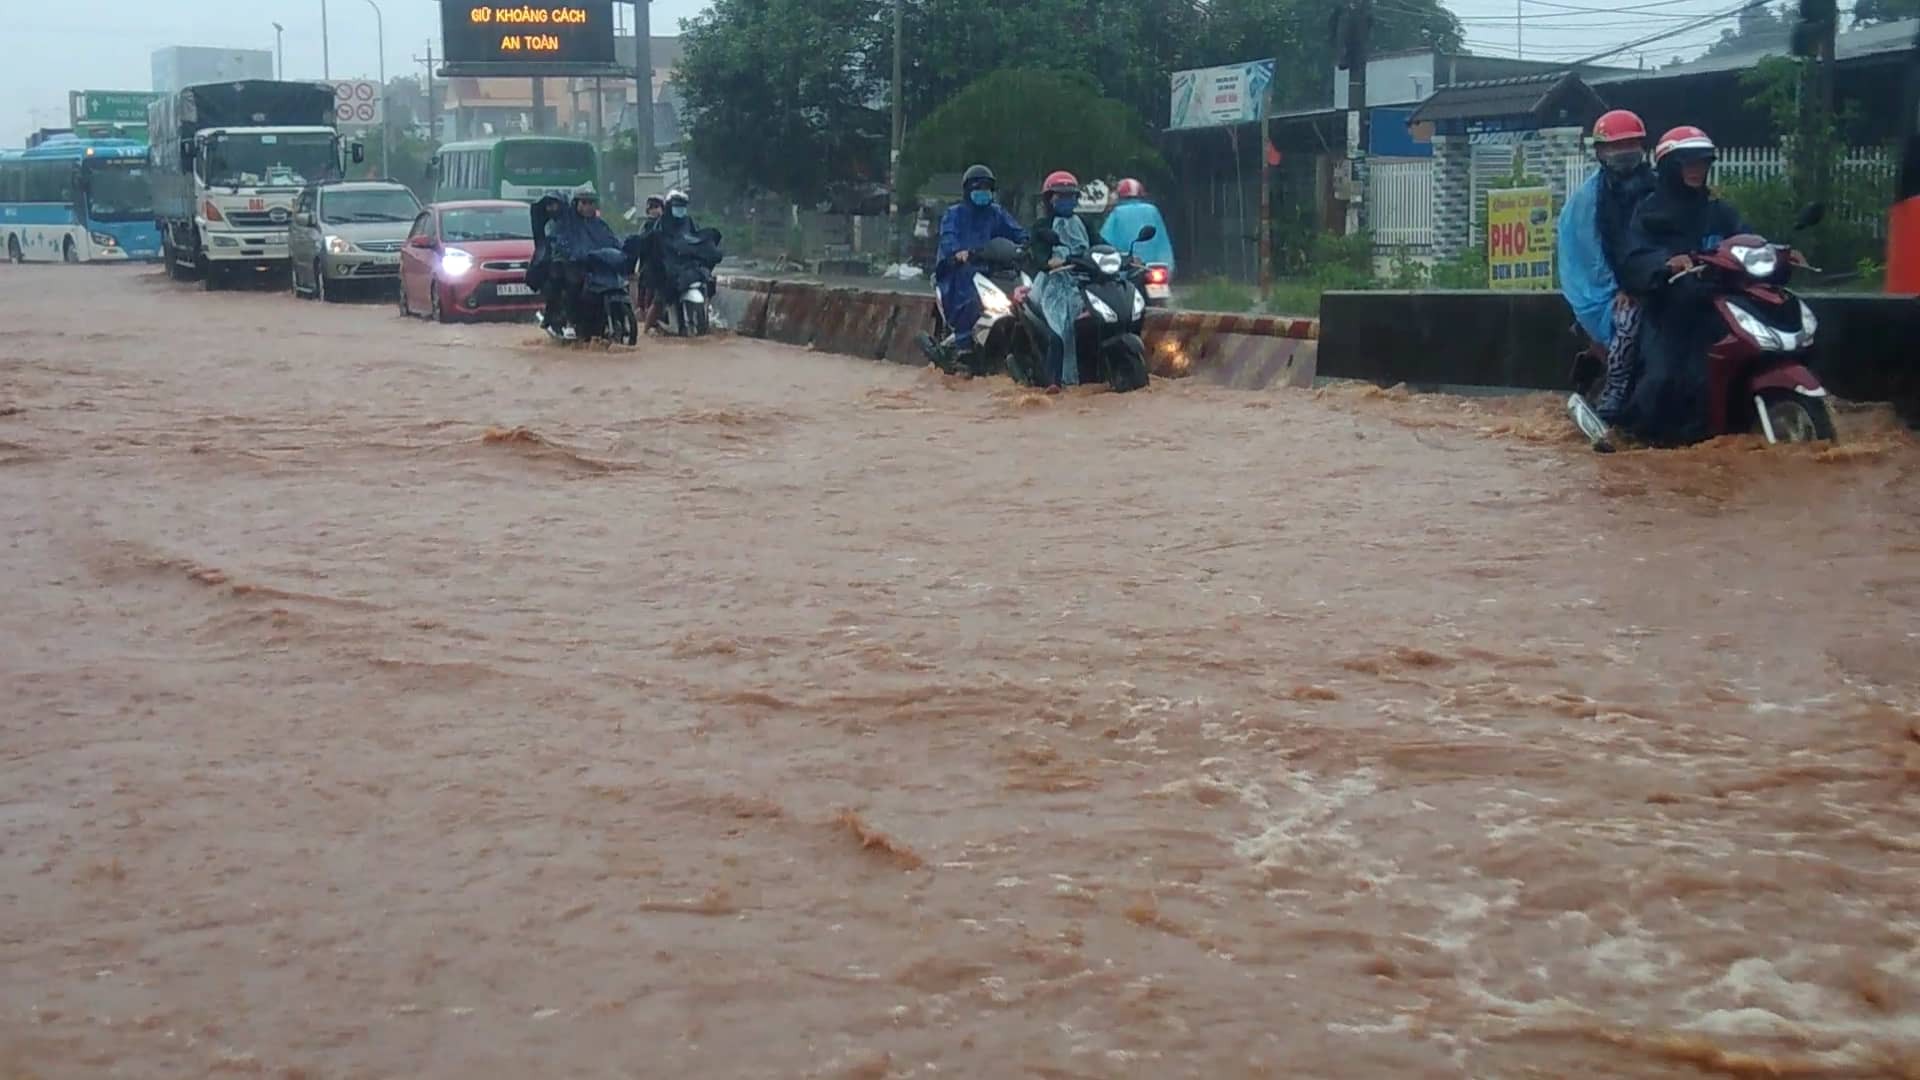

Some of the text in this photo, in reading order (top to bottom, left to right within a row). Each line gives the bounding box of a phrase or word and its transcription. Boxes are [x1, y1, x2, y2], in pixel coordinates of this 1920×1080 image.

[471, 6, 586, 23] GIỮ KHOẢNG CÁCH
[501, 35, 558, 50] AN TOÀN
